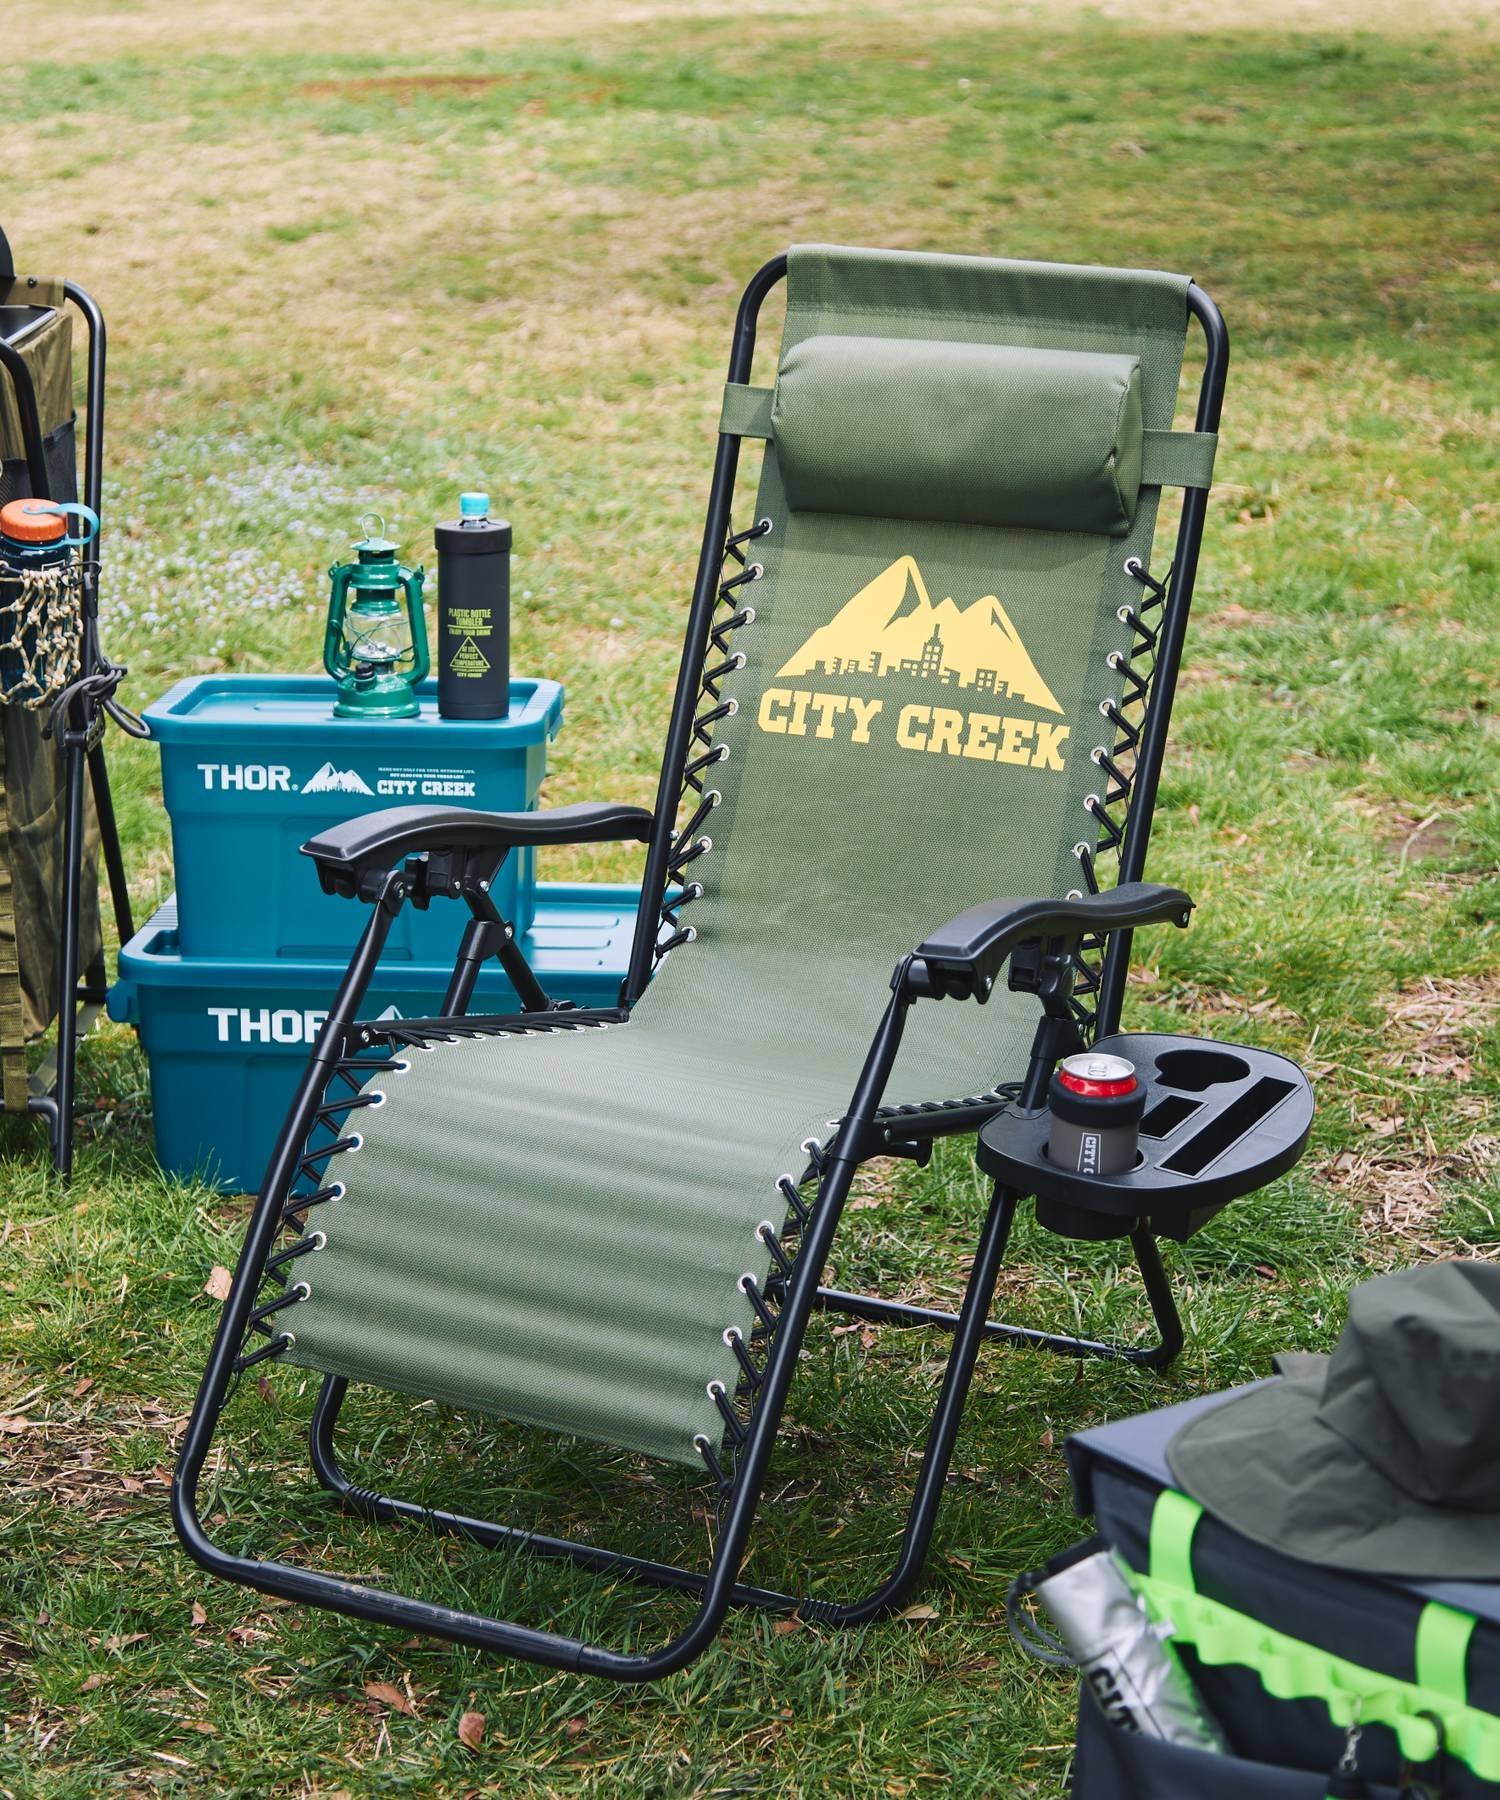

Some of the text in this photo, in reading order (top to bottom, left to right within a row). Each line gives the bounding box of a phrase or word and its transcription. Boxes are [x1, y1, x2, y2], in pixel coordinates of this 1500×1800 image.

[448, 607, 491, 618] PLASTIC BOTTLE
[456, 617, 483, 626] TUMBLER
[757, 688, 1071, 772] CITY CREEK
[377, 779, 476, 797] CITY CREEK
[1084, 1136, 1096, 1165] CITY
[1087, 1667, 1139, 1733] CIT
